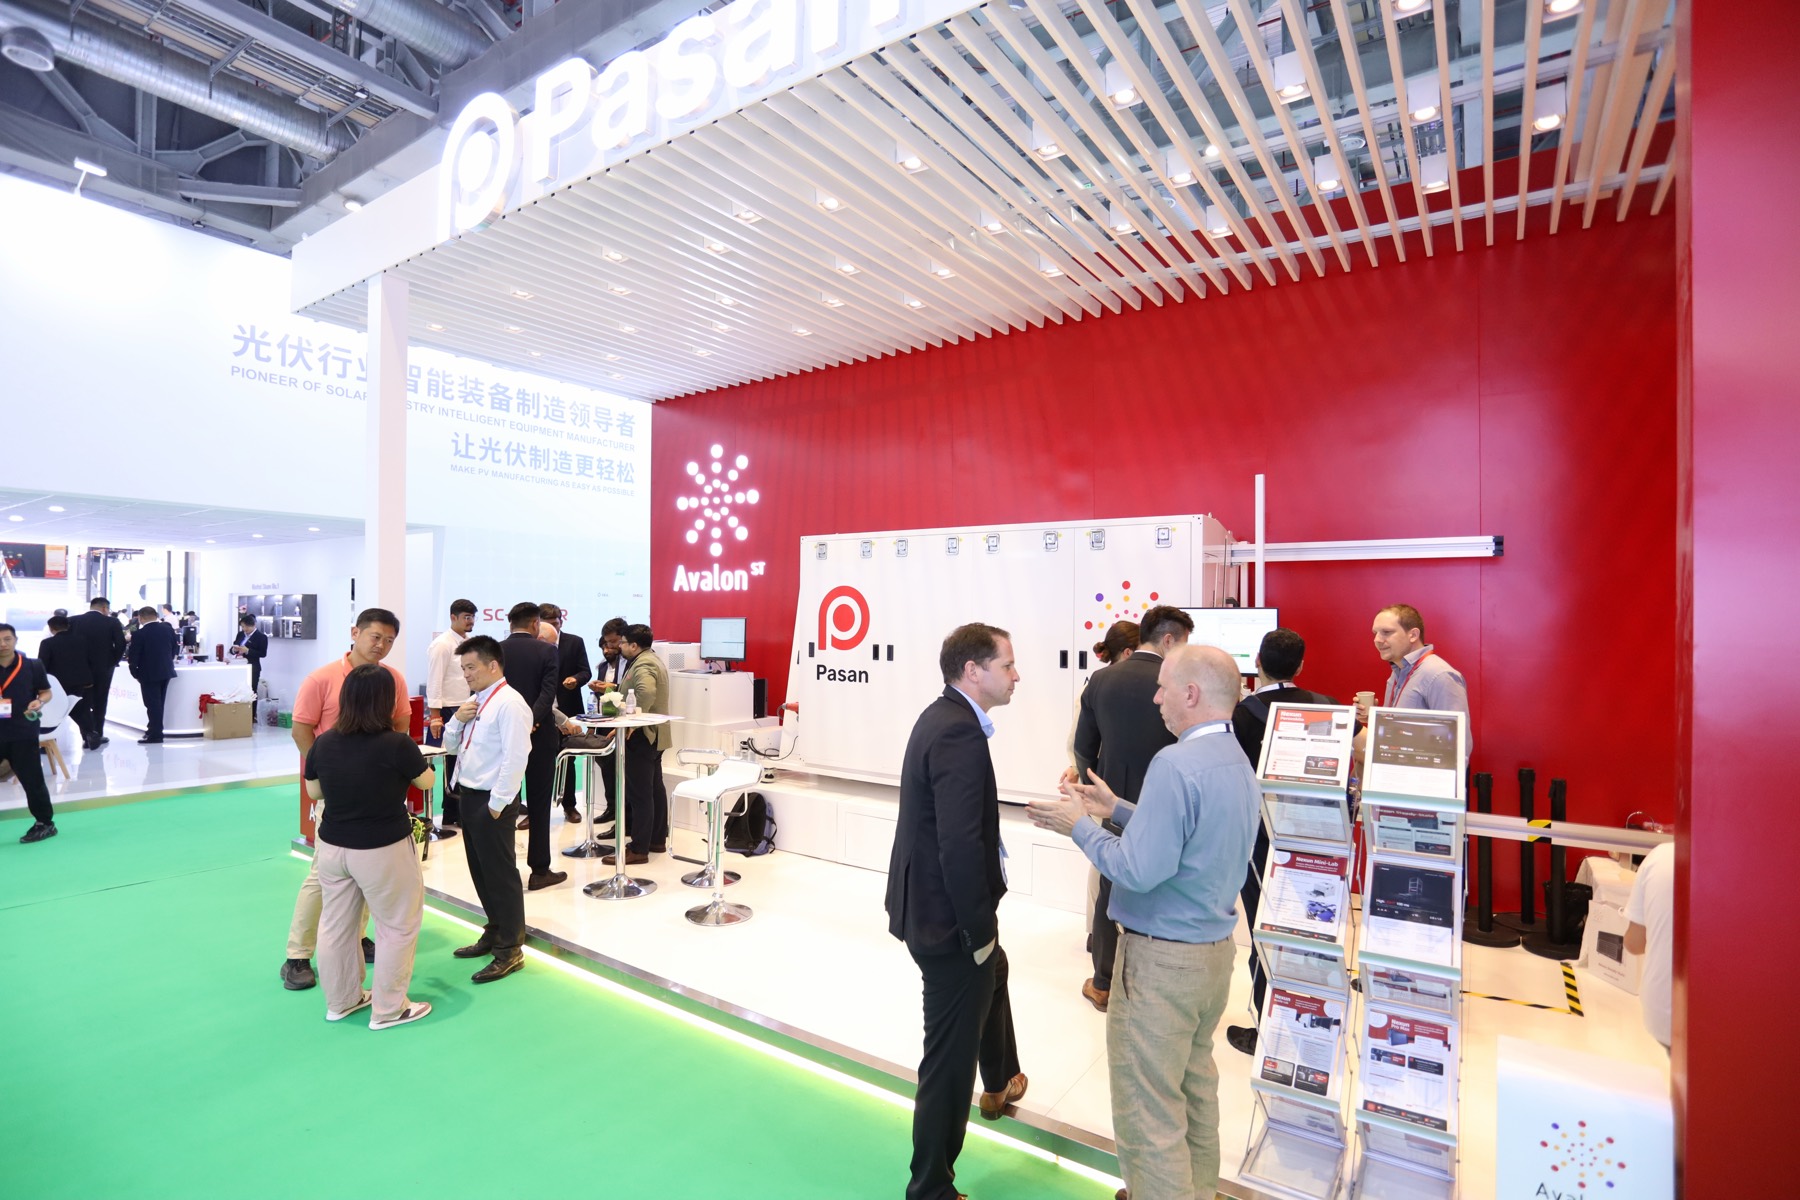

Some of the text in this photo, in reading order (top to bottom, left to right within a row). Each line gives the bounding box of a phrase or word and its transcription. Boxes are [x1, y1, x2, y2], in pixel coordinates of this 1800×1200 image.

[231, 365, 298, 388] PIONEER
[302, 380, 322, 392] OF
[406, 401, 435, 415] STRY
[438, 407, 507, 429] INTELLIGENT
[509, 421, 566, 440] EQUIPMENT
[566, 432, 635, 452] MANUFACTURER
[451, 432, 635, 484] 让光伏制造更轻松
[450, 464, 635, 497] MAKE PV MANUFACTURING AS EASY AS POSSIBLE
[673, 561, 766, 592] Avalon ST
[816, 664, 869, 683] Pasan
[1536, 1182, 1584, 1200] Av
